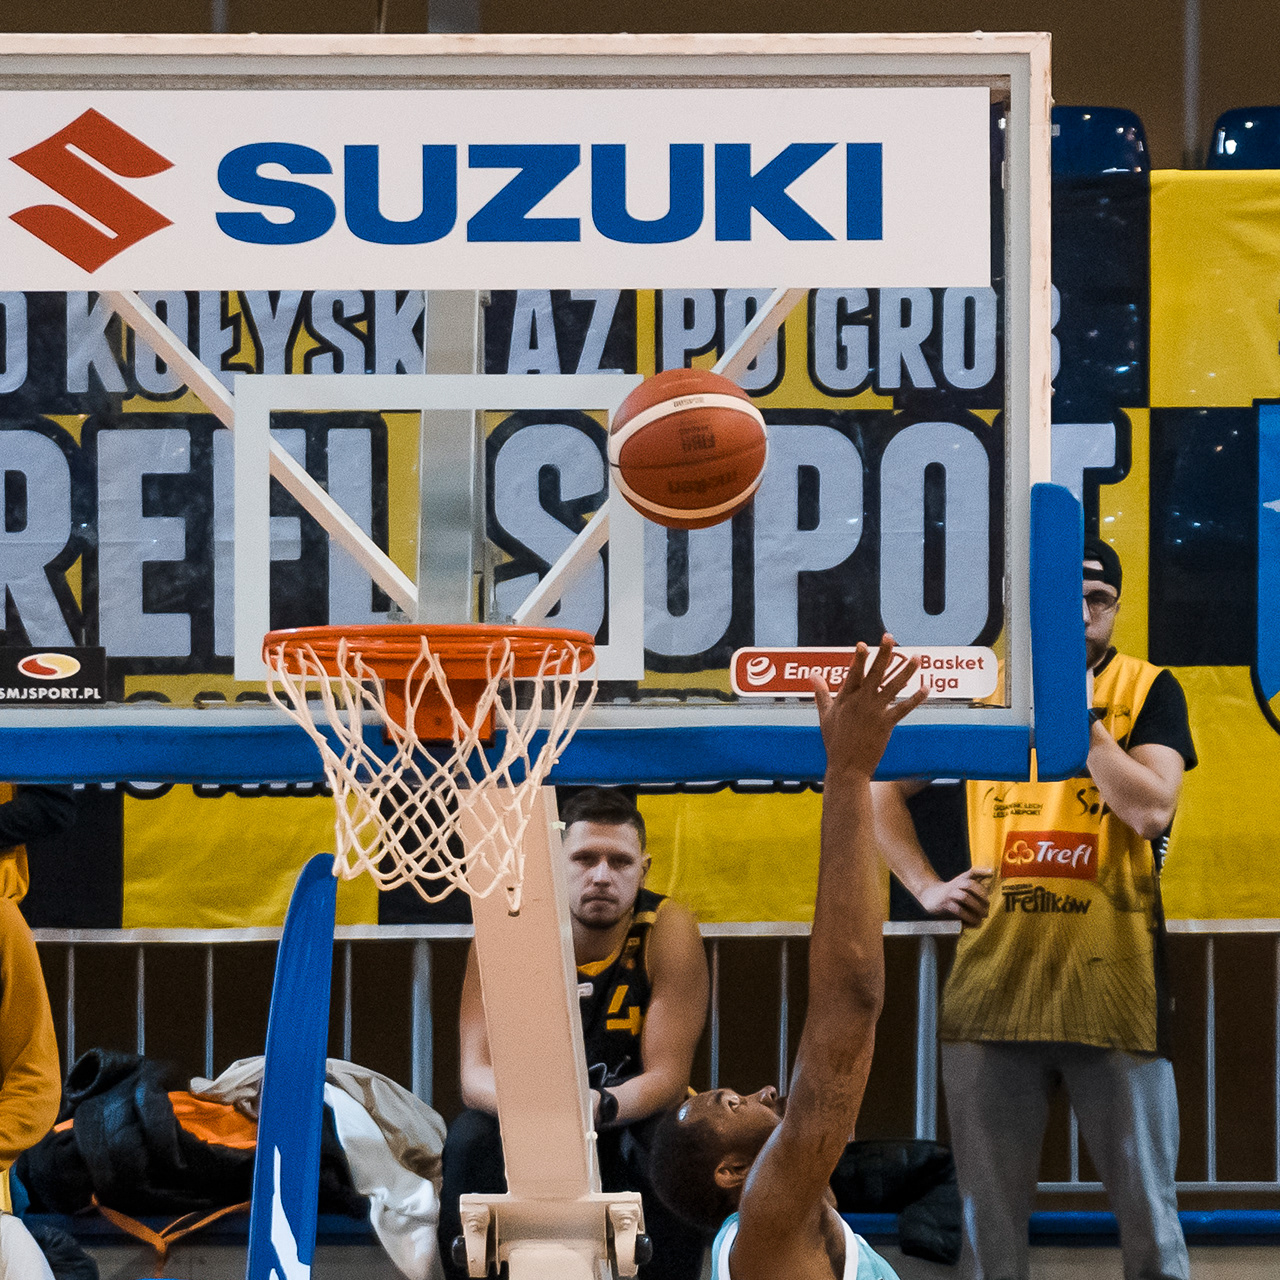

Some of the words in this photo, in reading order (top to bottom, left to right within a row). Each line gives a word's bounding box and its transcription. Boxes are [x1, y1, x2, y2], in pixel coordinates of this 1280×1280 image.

[215, 141, 883, 244] SUZUKI
[66, 291, 426, 394] KOŁYSK
[919, 655, 984, 671] Basket
[1036, 840, 1092, 869] Trefl
[606, 984, 641, 1036] 4
